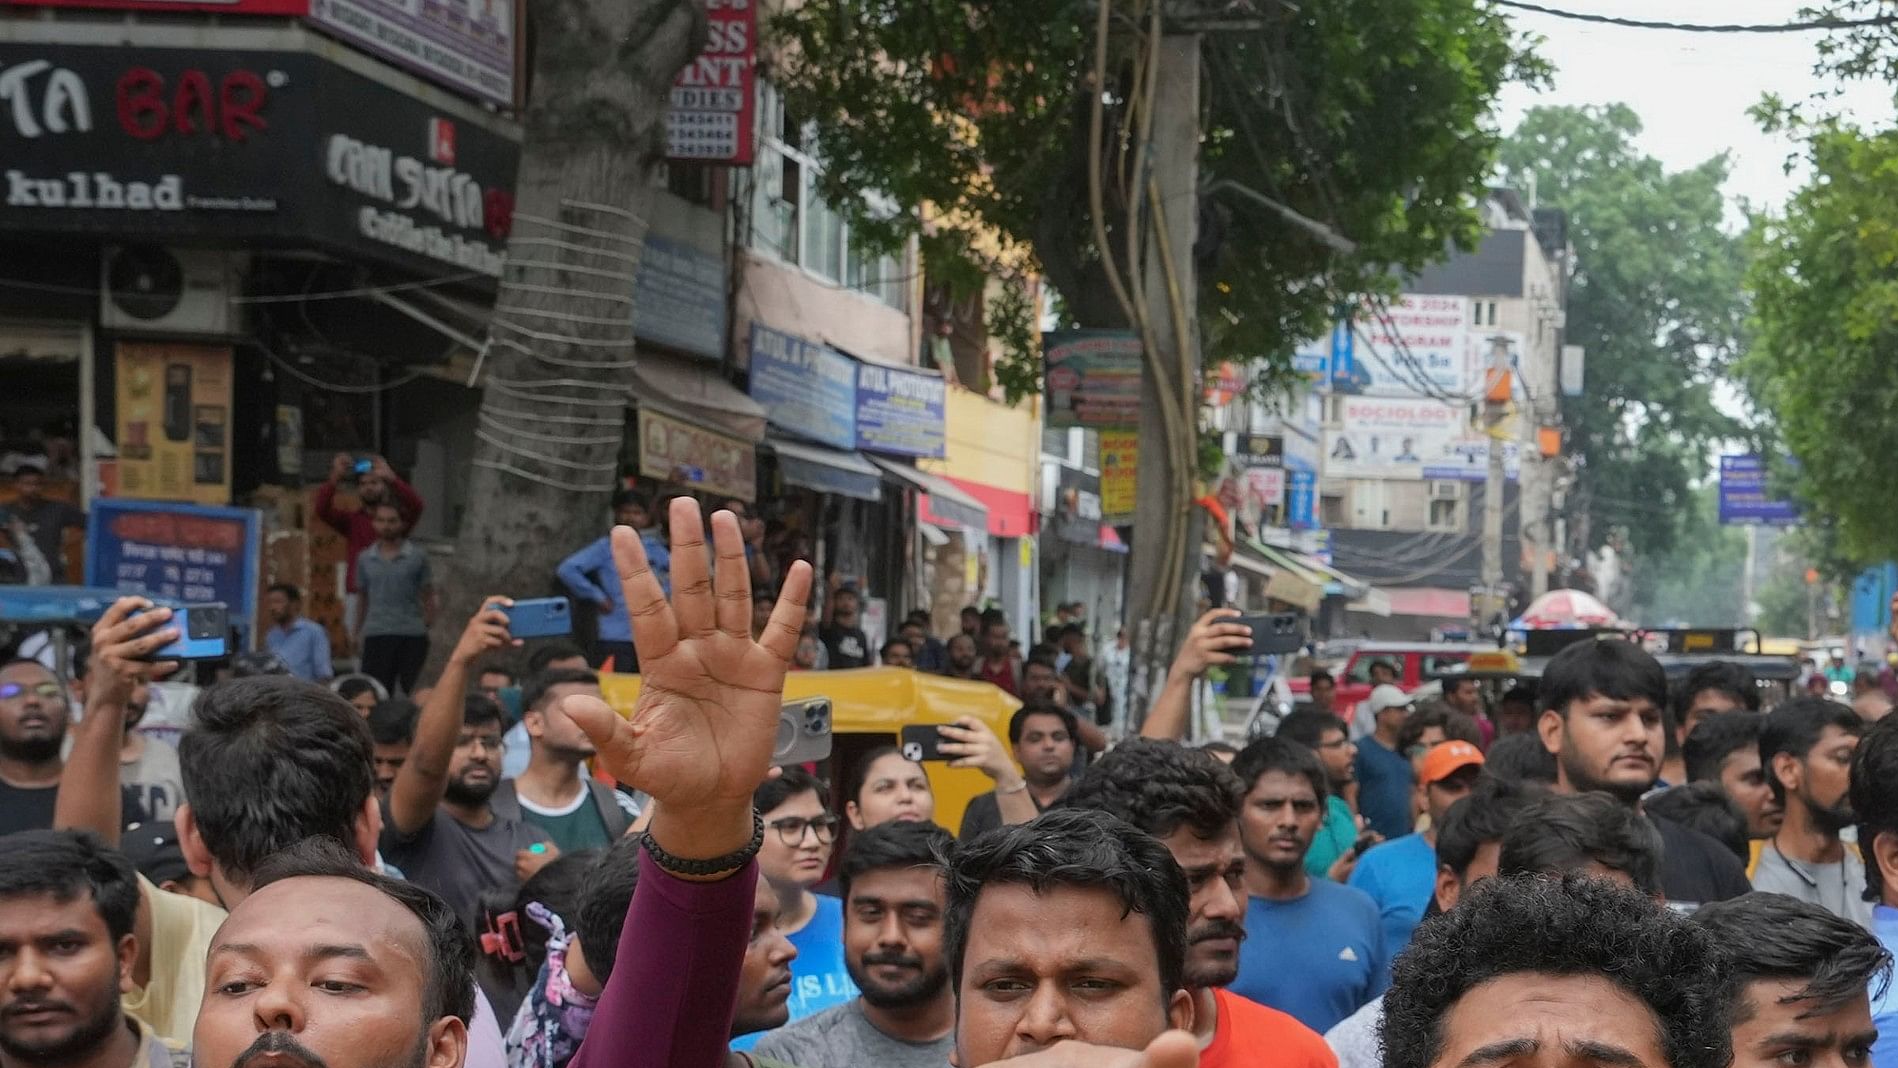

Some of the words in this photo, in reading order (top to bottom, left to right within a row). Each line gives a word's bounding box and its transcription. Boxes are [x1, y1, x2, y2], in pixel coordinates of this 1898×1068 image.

[115, 66, 269, 142] BAR
[5, 168, 185, 211] kulhad
[1348, 404, 1460, 419] SOCIOLOGY
